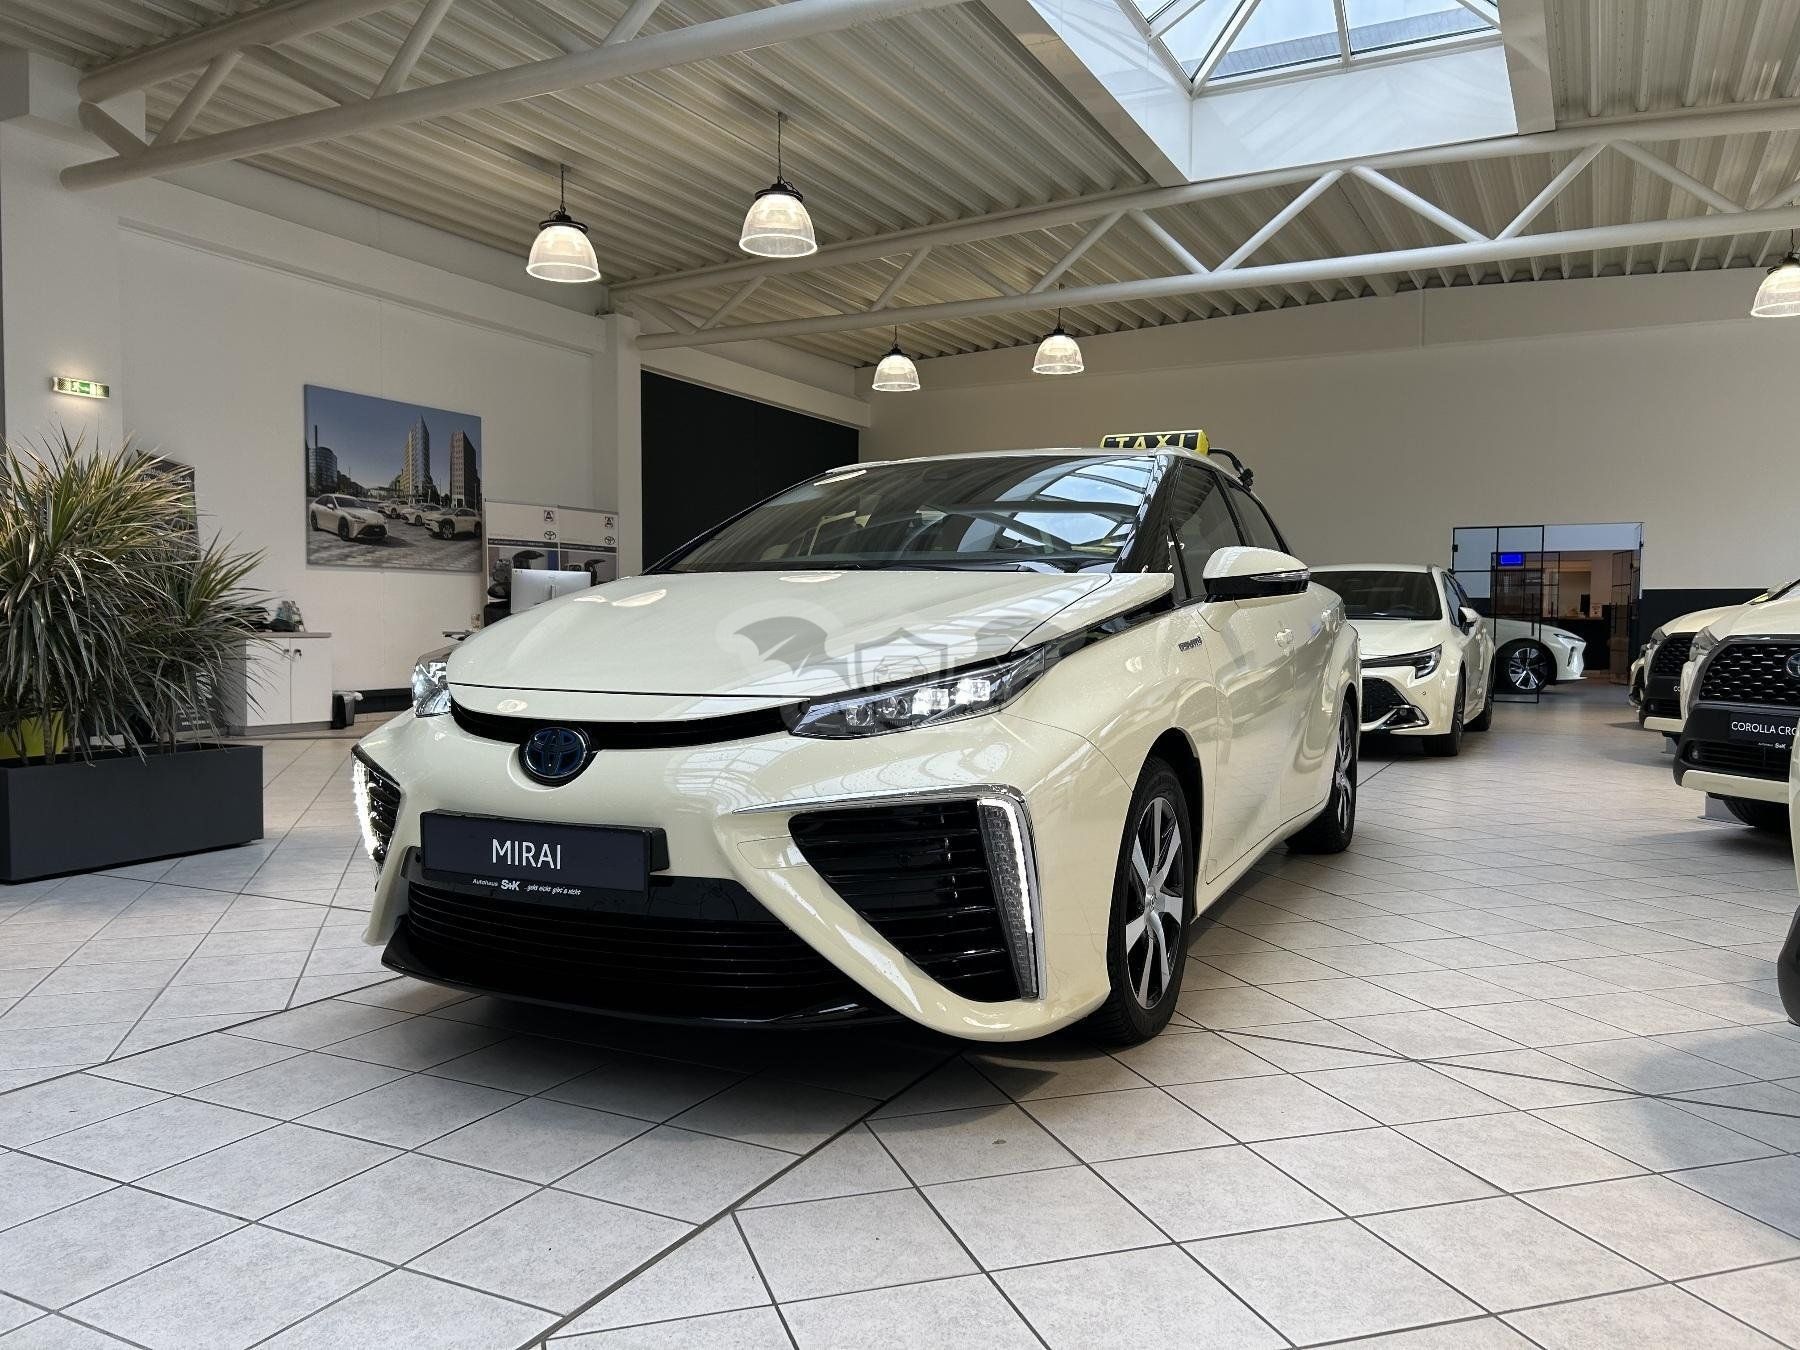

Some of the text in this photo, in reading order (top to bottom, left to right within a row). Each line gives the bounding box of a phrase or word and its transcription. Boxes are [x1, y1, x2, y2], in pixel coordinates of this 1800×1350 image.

[1116, 433, 1186, 449] TAXI
[1731, 721, 1776, 734] COROLLA
[492, 838, 561, 870] MIRAI
